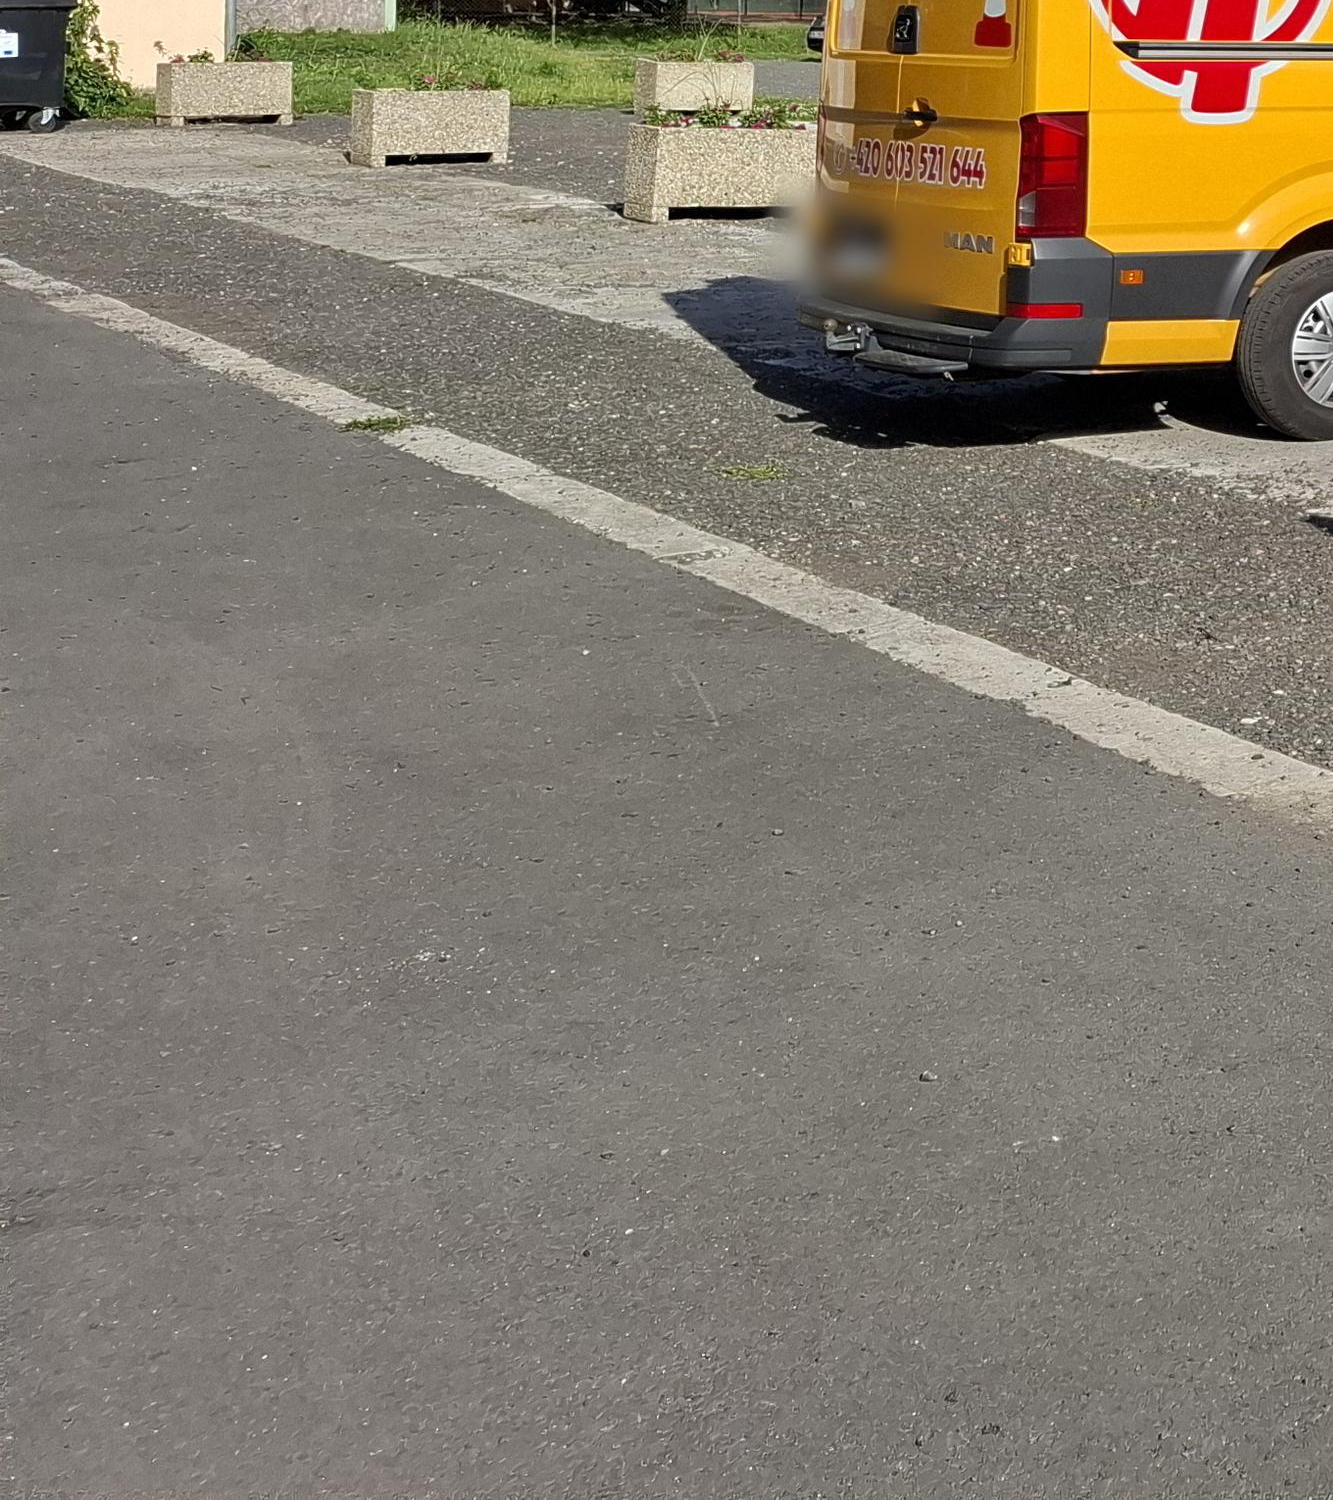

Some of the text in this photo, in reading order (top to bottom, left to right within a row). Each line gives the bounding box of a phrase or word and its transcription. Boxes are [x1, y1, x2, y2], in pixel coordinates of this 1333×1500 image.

[885, 141, 914, 180] 603
[918, 144, 945, 184] 521
[950, 146, 986, 188] 644
